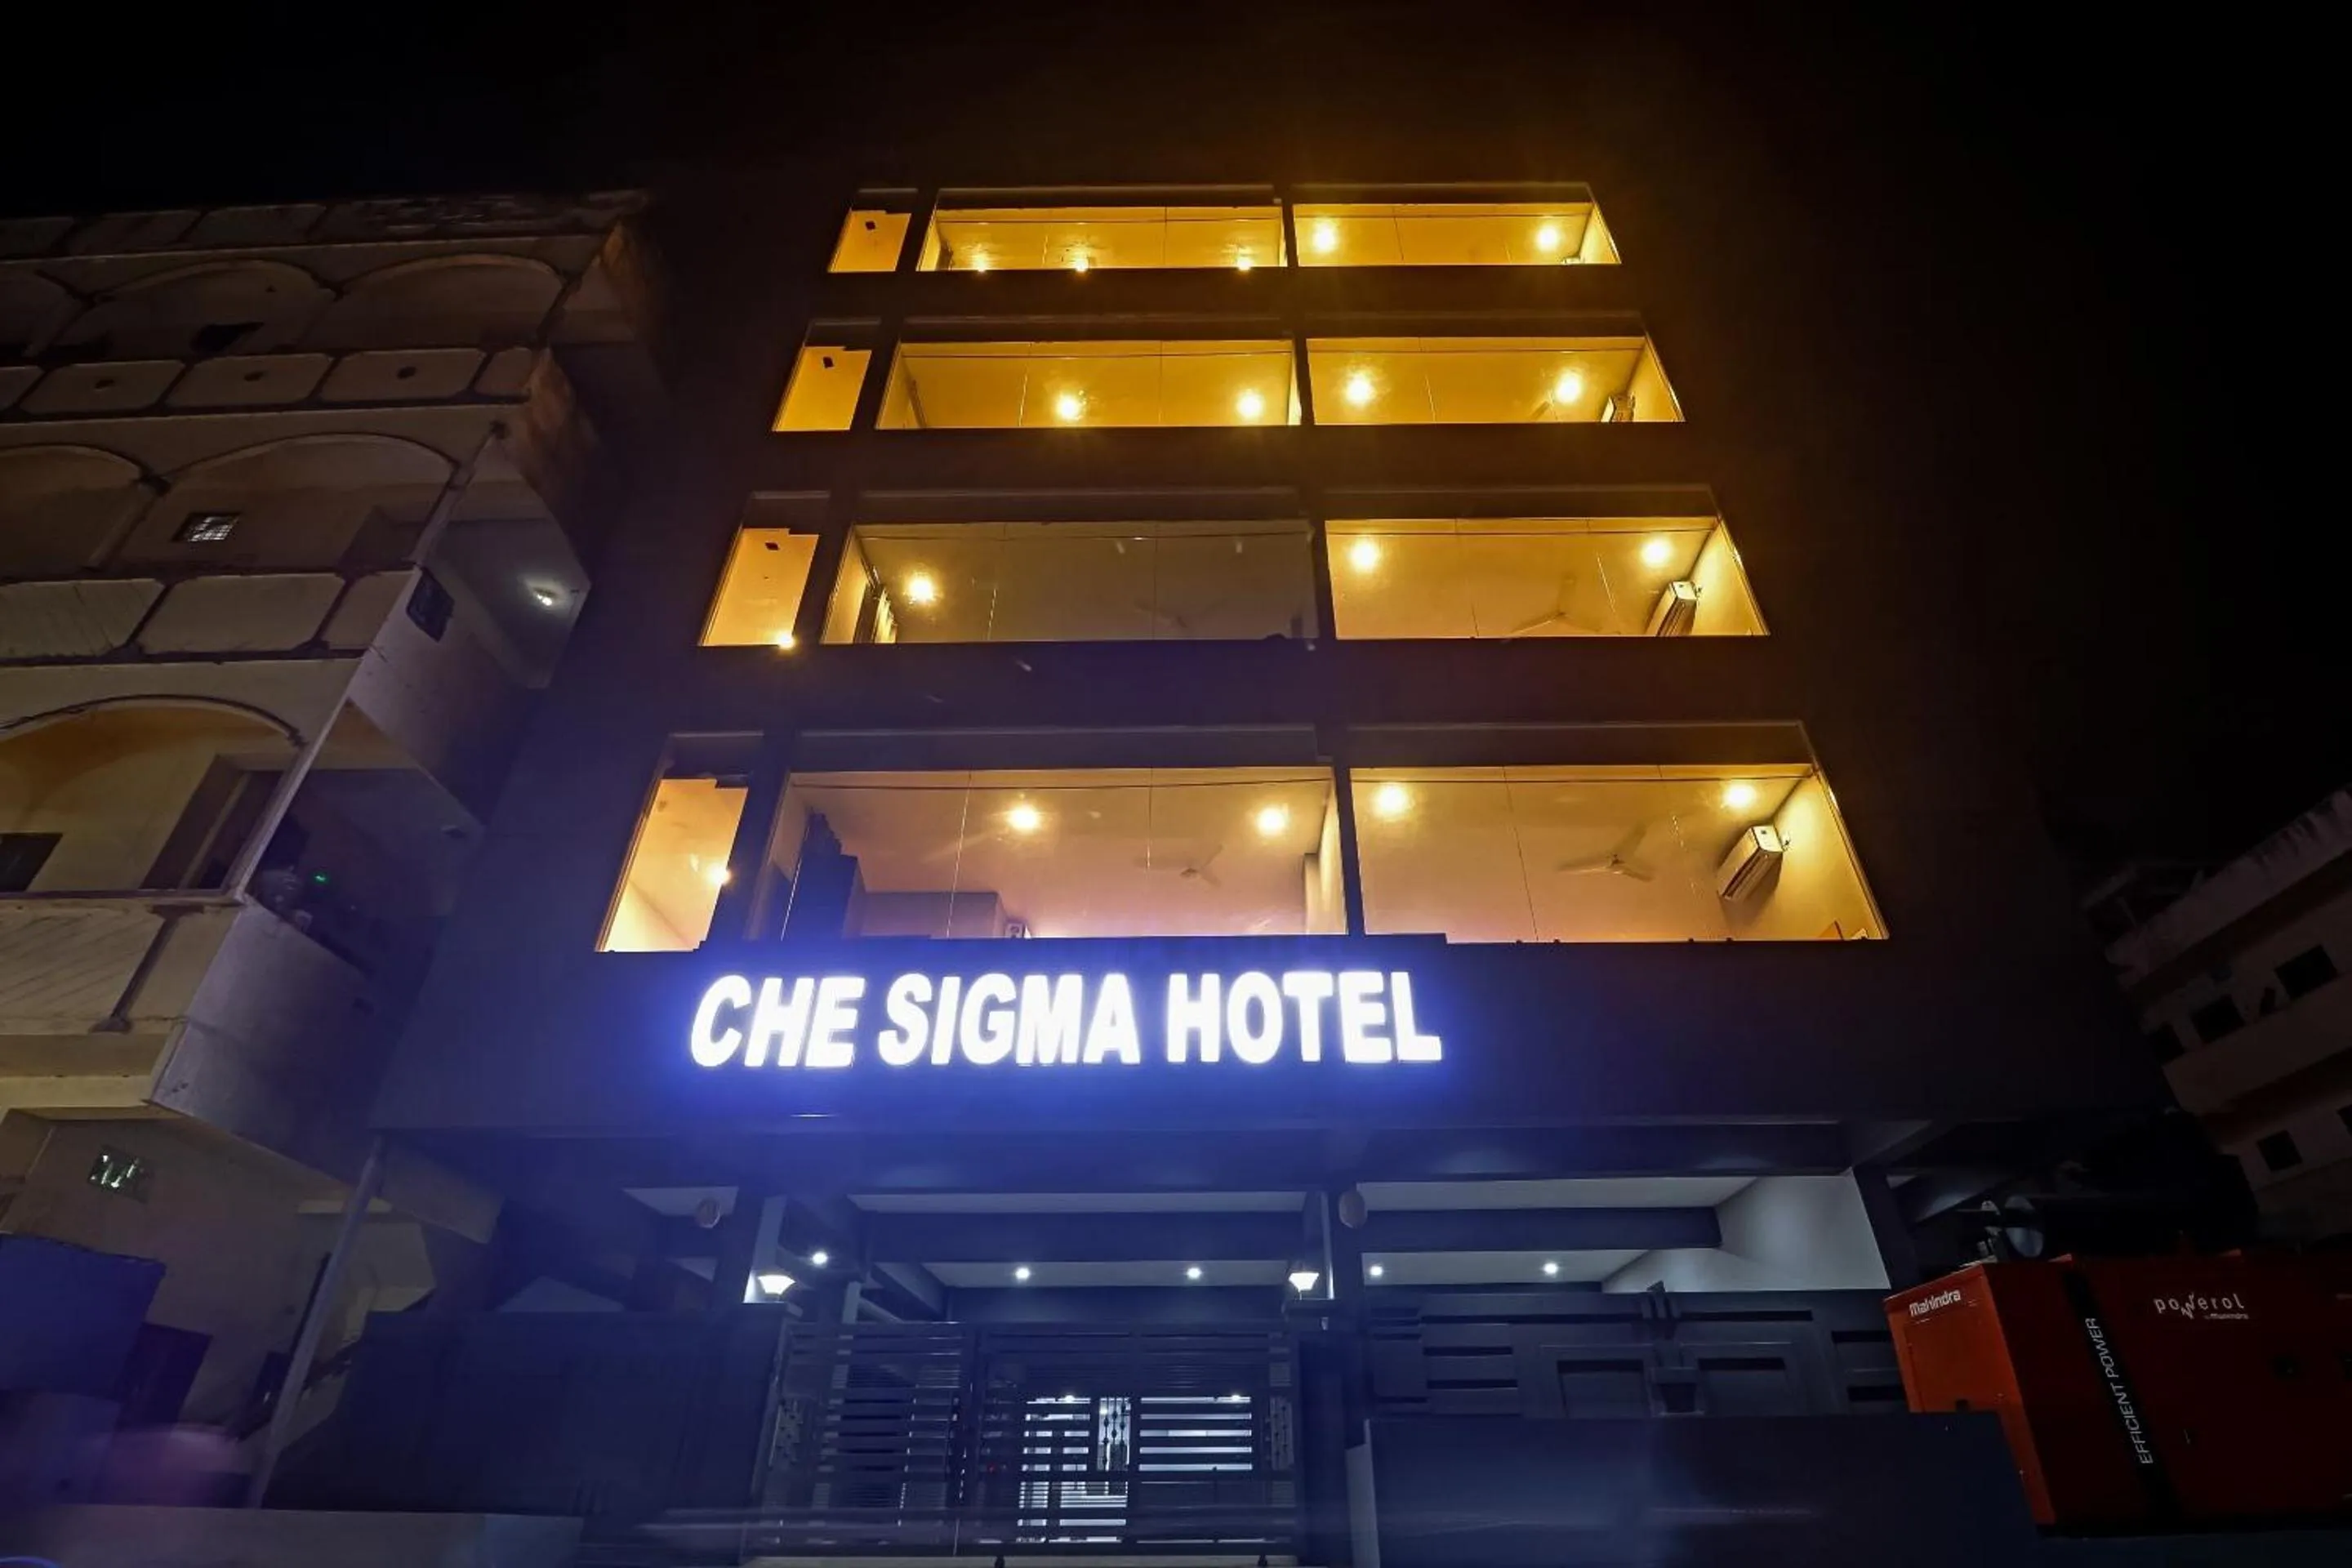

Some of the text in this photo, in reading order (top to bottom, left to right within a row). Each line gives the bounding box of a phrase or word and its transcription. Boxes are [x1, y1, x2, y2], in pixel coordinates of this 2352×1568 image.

[691, 970, 1443, 1067] CHE SIGMA HOTEL
[2084, 1316, 2154, 1464] EFFICIENT POWER
